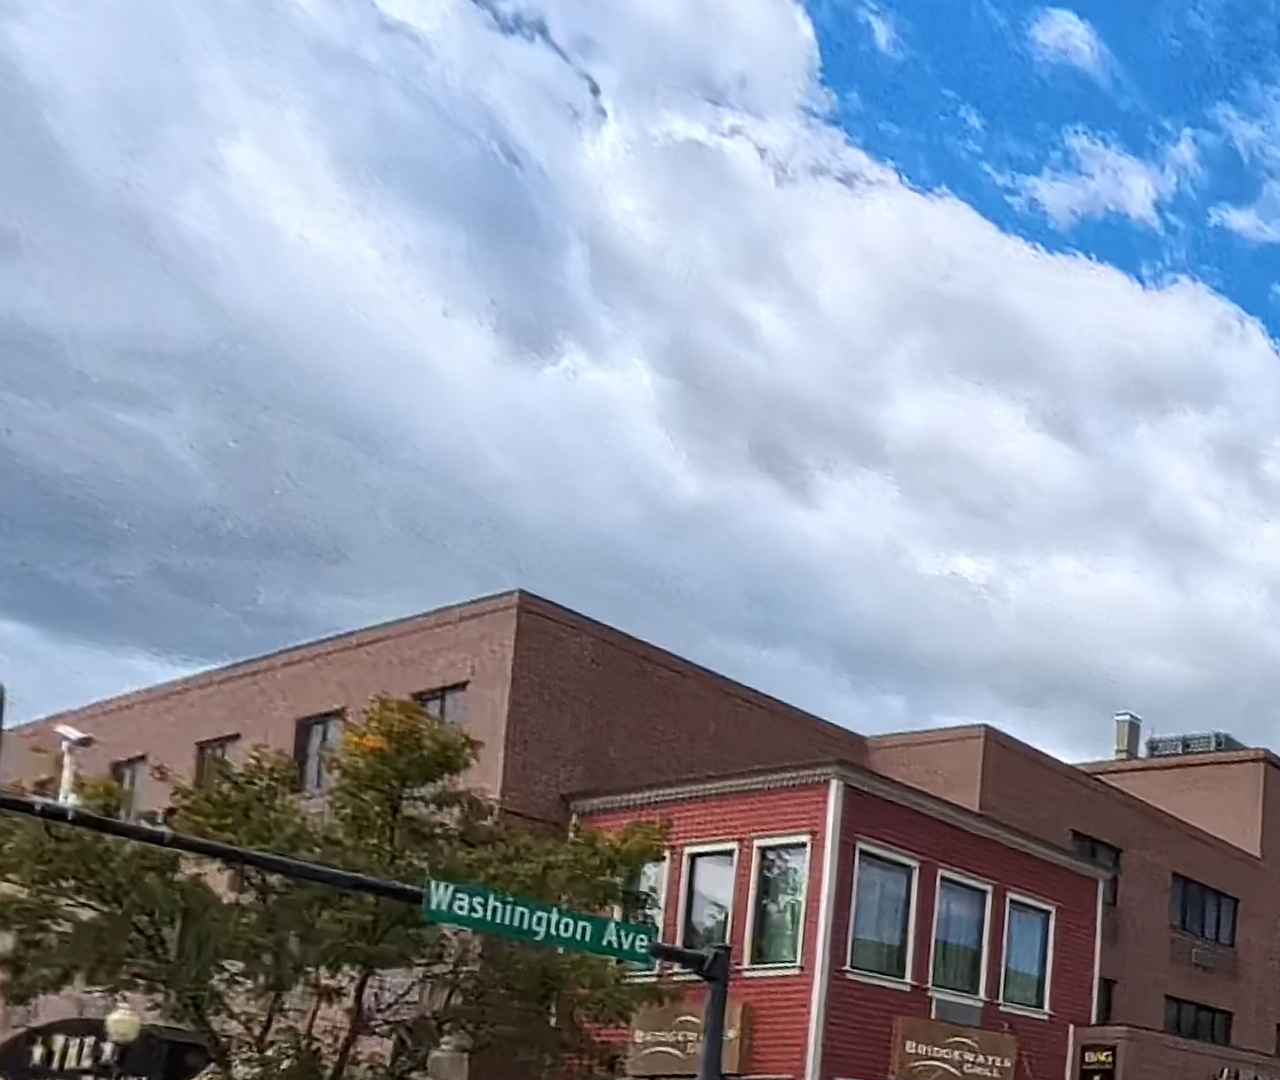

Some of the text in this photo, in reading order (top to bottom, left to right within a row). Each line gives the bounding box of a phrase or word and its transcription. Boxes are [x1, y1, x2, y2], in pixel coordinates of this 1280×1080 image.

[428, 879, 649, 953] Washington Ave
[52, 1033, 96, 1071] THE
